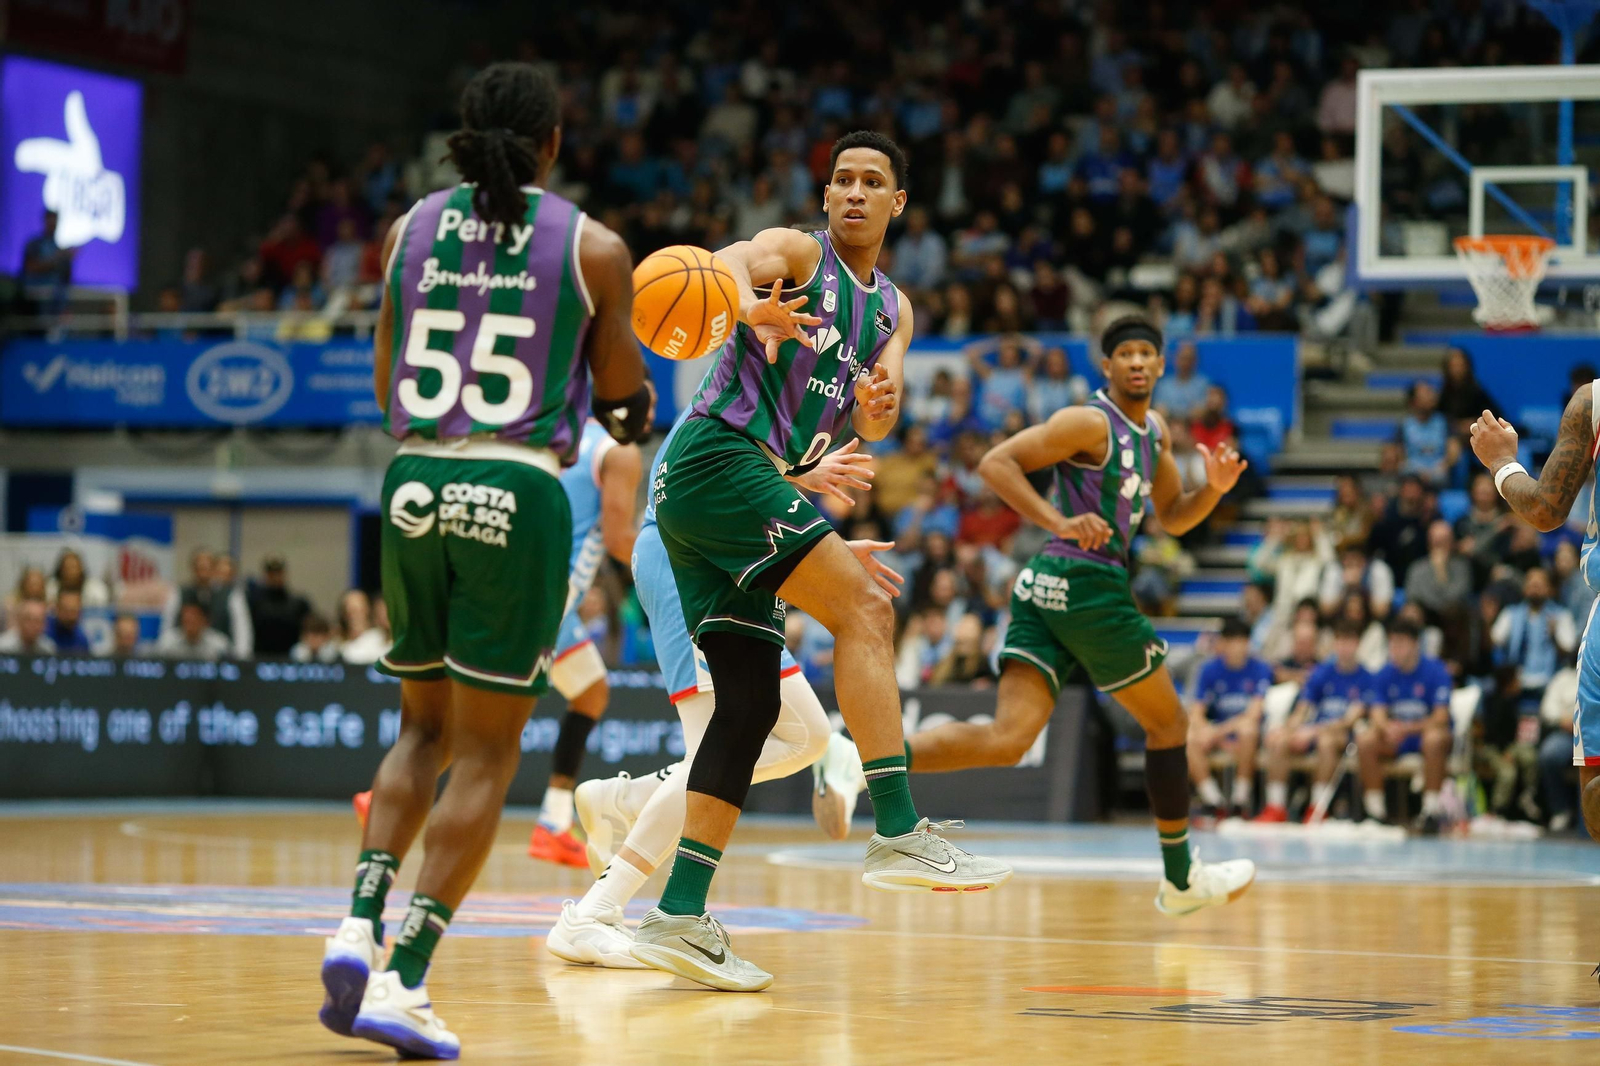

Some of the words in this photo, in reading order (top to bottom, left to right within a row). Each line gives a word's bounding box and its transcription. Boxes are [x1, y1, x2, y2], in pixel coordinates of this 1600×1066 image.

[436, 209, 535, 255] Perry
[398, 308, 536, 425] 55
[799, 431, 832, 467] 0
[441, 482, 517, 514] COSTA
[473, 506, 513, 532] SOL
[0, 698, 99, 752] hoosing
[107, 707, 152, 744] one
[158, 699, 192, 744] of
[198, 701, 259, 746] the
[275, 703, 365, 748] Safe
